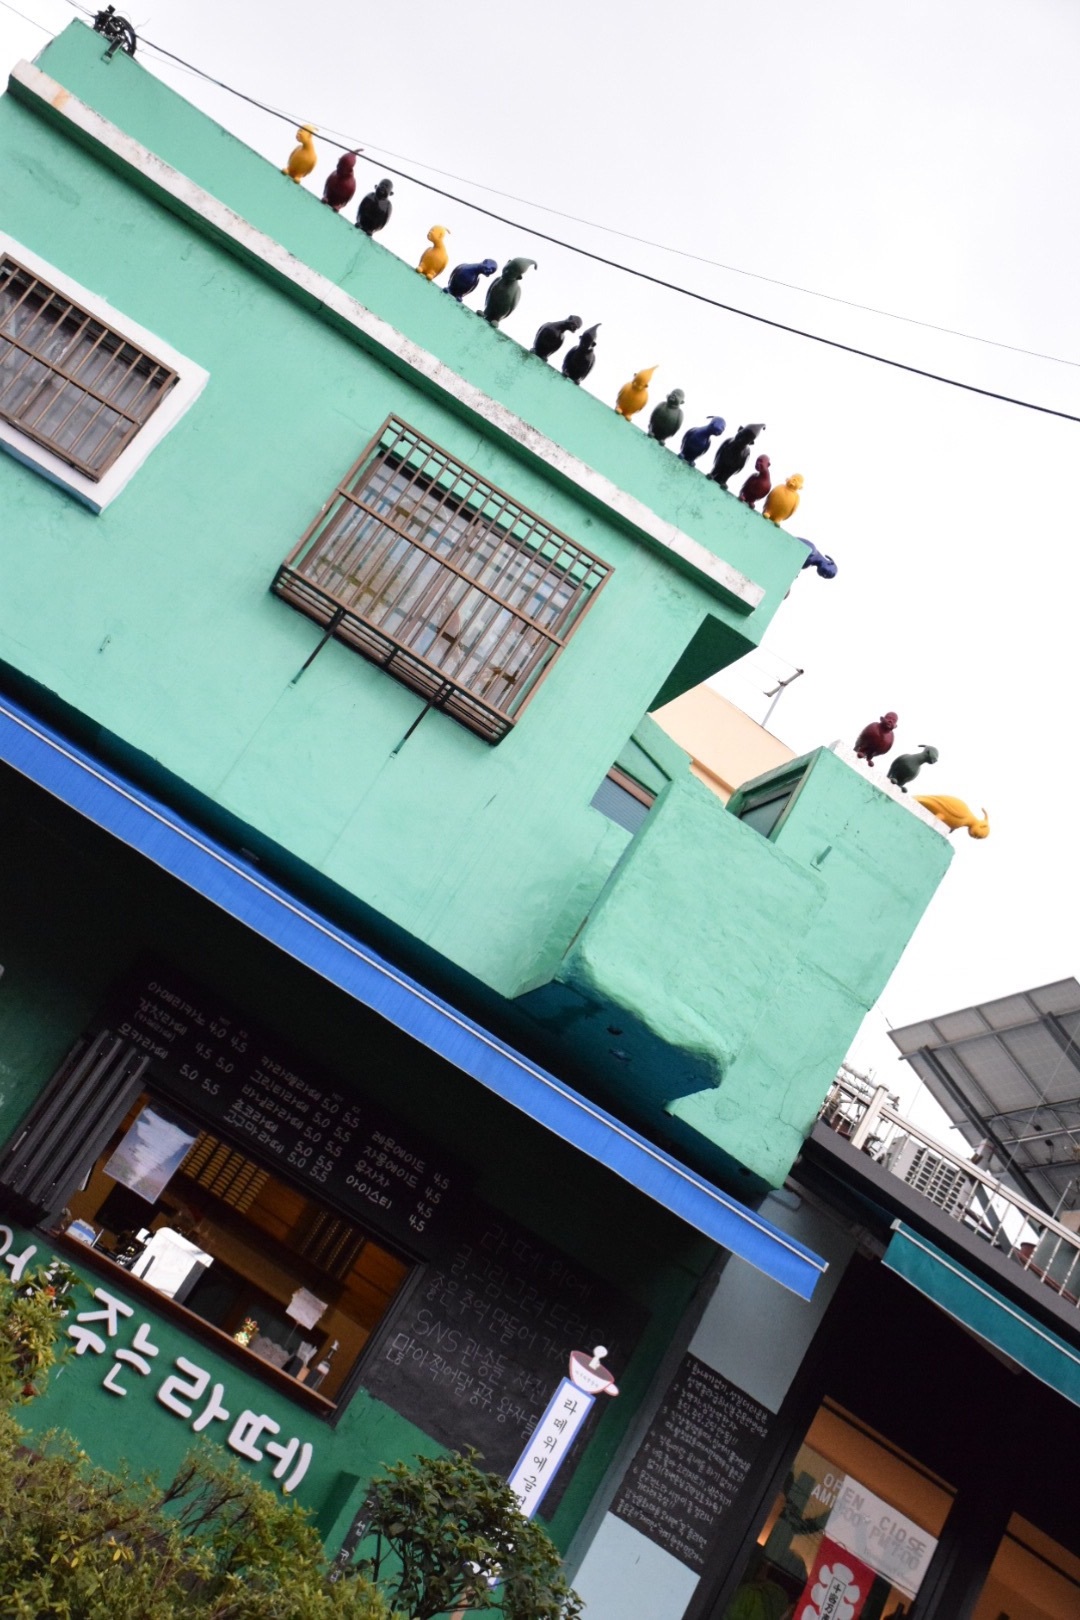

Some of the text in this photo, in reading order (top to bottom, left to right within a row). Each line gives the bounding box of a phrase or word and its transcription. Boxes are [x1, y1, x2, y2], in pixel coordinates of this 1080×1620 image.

[147, 981, 247, 1053] 아메리카노 4.0 4.5
[179, 1063, 198, 1080] 5.0
[201, 1077, 219, 1095] 5.5
[195, 1042, 212, 1059] 4.5
[215, 1056, 234, 1073] 5.0
[231, 1098, 333, 1171] 초코라떼 5.0 5.5
[241, 1083, 342, 1157] 바닐라라떼 5.0 5.5
[249, 1069, 351, 1142] 그린티라떼 5.0 5.5
[320, 1097, 339, 1113] 5.0
[341, 1111, 359, 1128] 5.5
[286, 1151, 306, 1168] 5.0
[308, 1165, 328, 1182] 5.5
[354, 1159, 432, 1218] 유자차 4.5
[362, 1145, 441, 1203] 자몽에이드 4.5
[371, 1130, 449, 1189] 레몬에이드 4.5
[345, 1174, 425, 1231] 아이스티 4.5
[408, 1307, 463, 1353] SNS
[67, 1287, 159, 1395] 주는
[157, 1356, 313, 1491] 라떼
